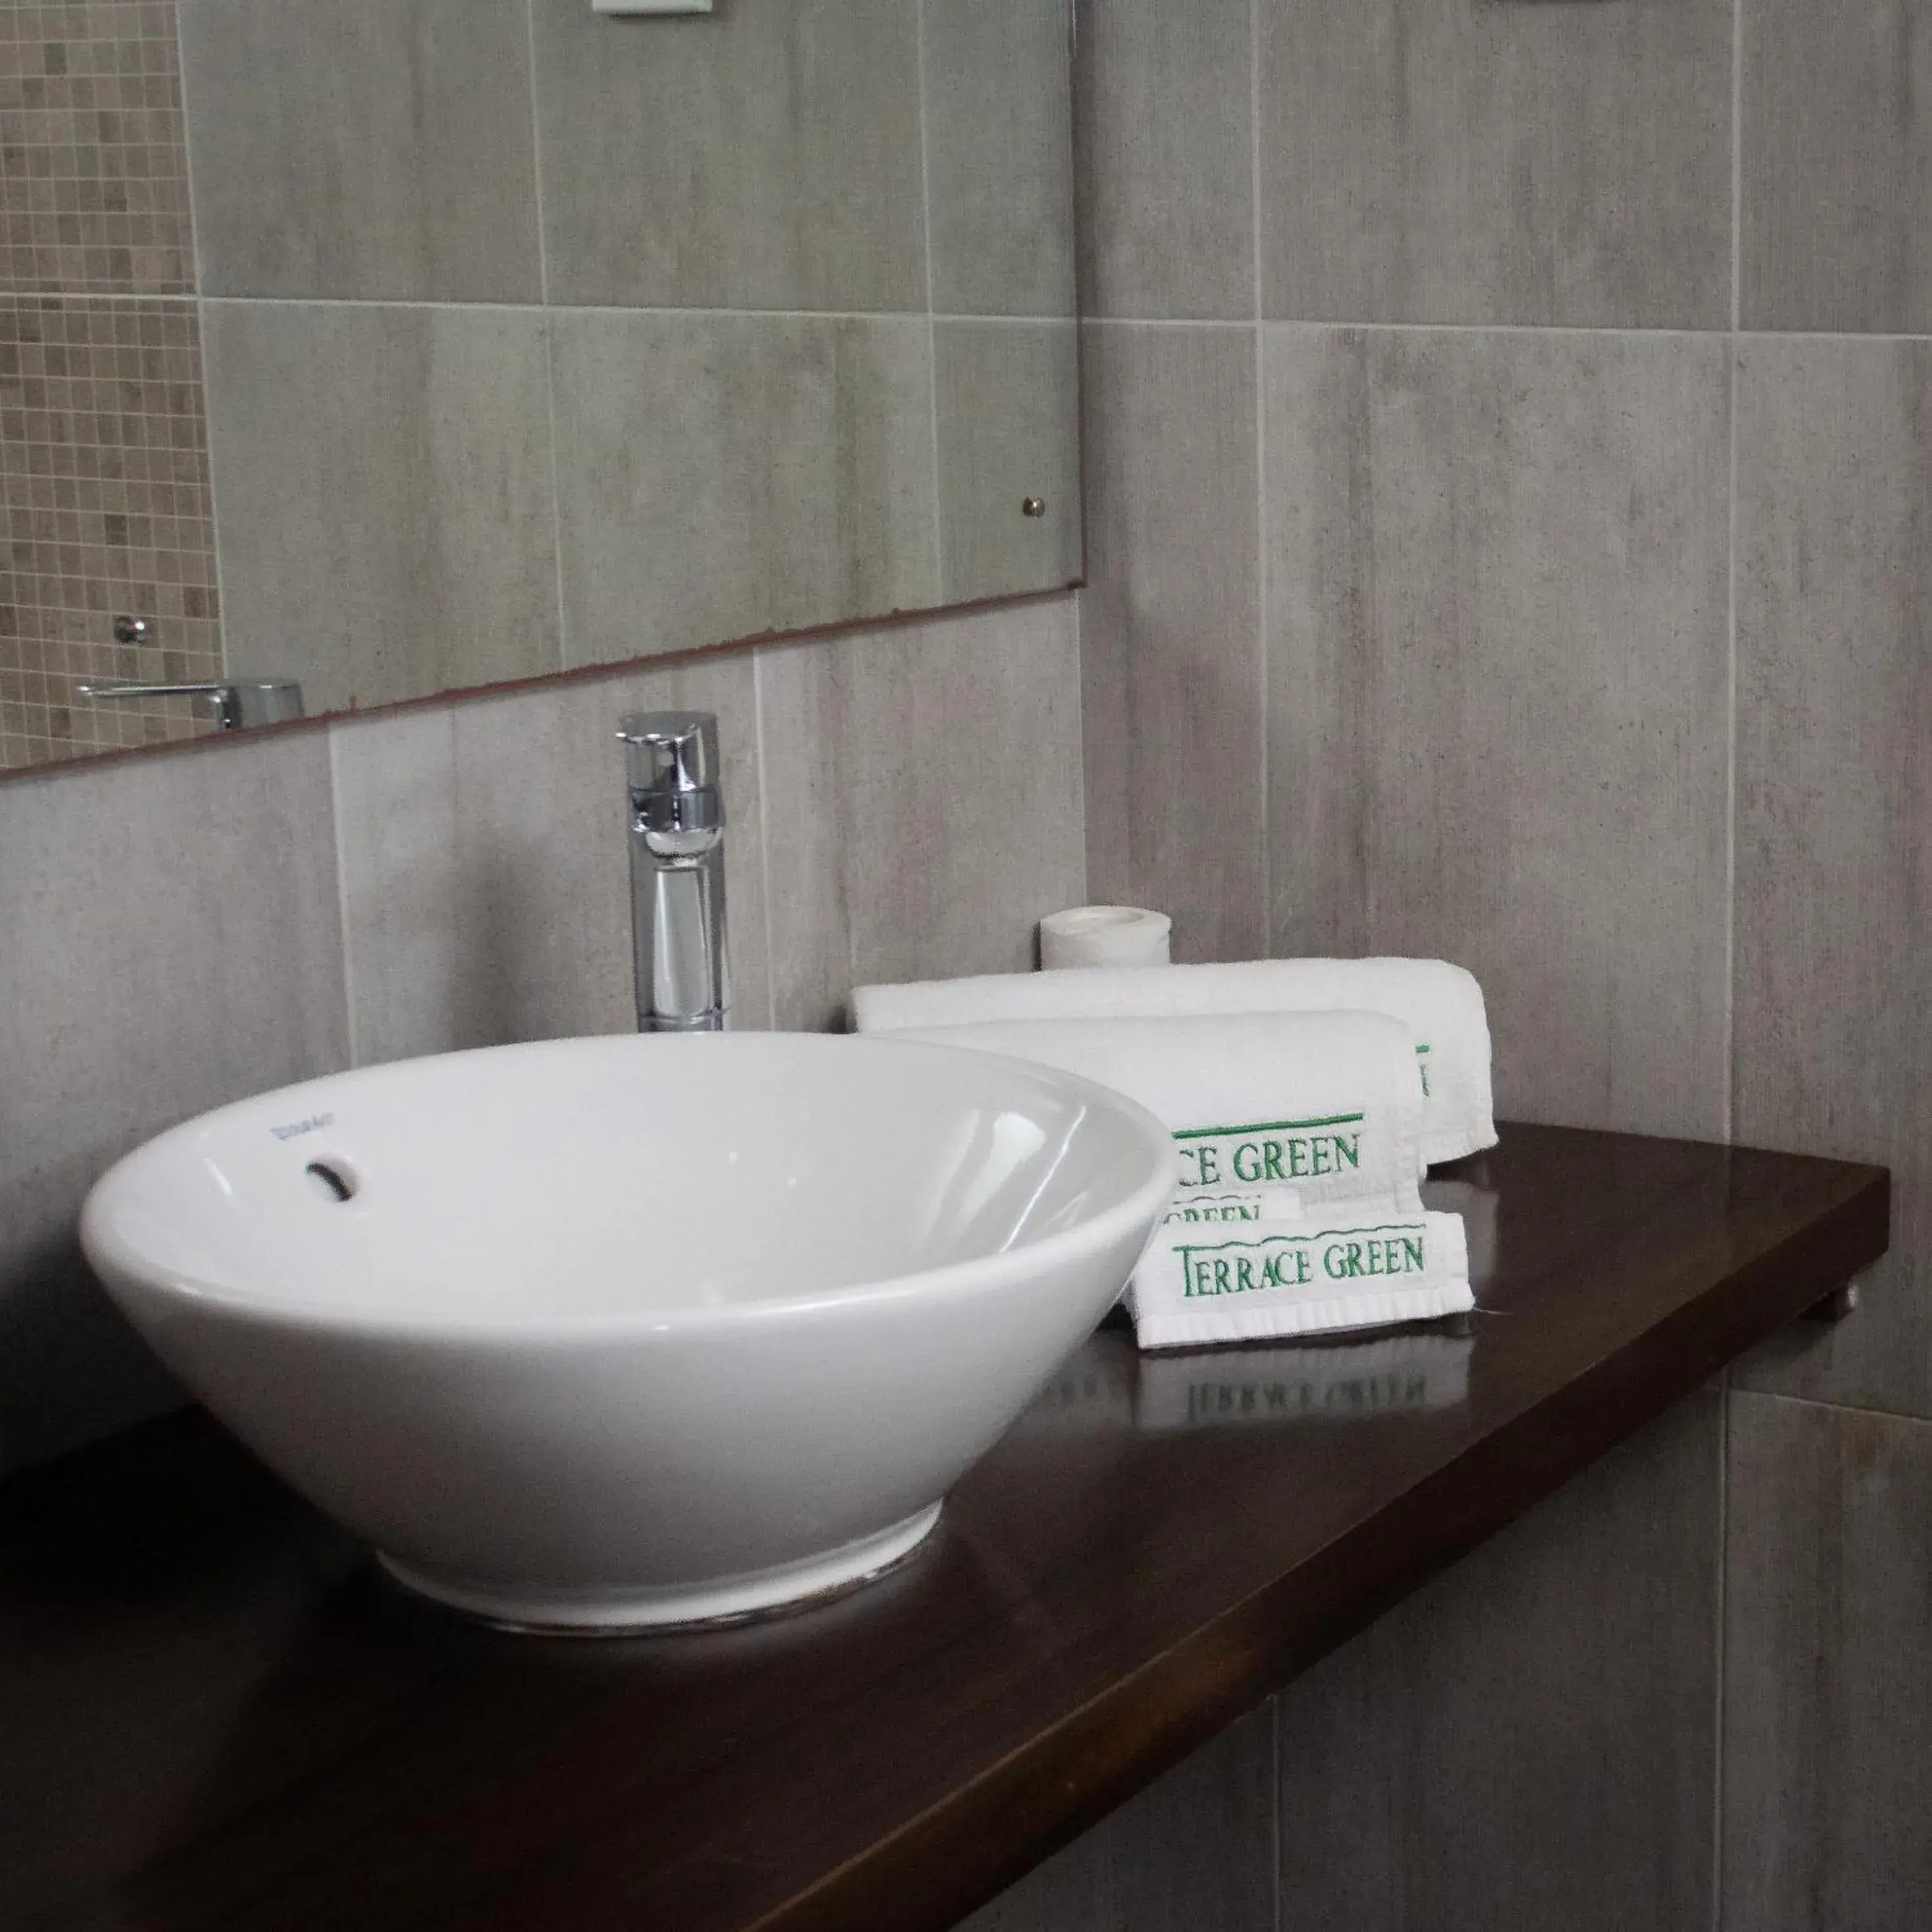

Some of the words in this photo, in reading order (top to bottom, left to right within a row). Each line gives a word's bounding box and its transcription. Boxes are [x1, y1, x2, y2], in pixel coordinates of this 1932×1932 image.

[1232, 1132, 1360, 1182] GREEN
[1179, 1246, 1313, 1297] TERRACE
[1322, 1236, 1425, 1279] GREEN
